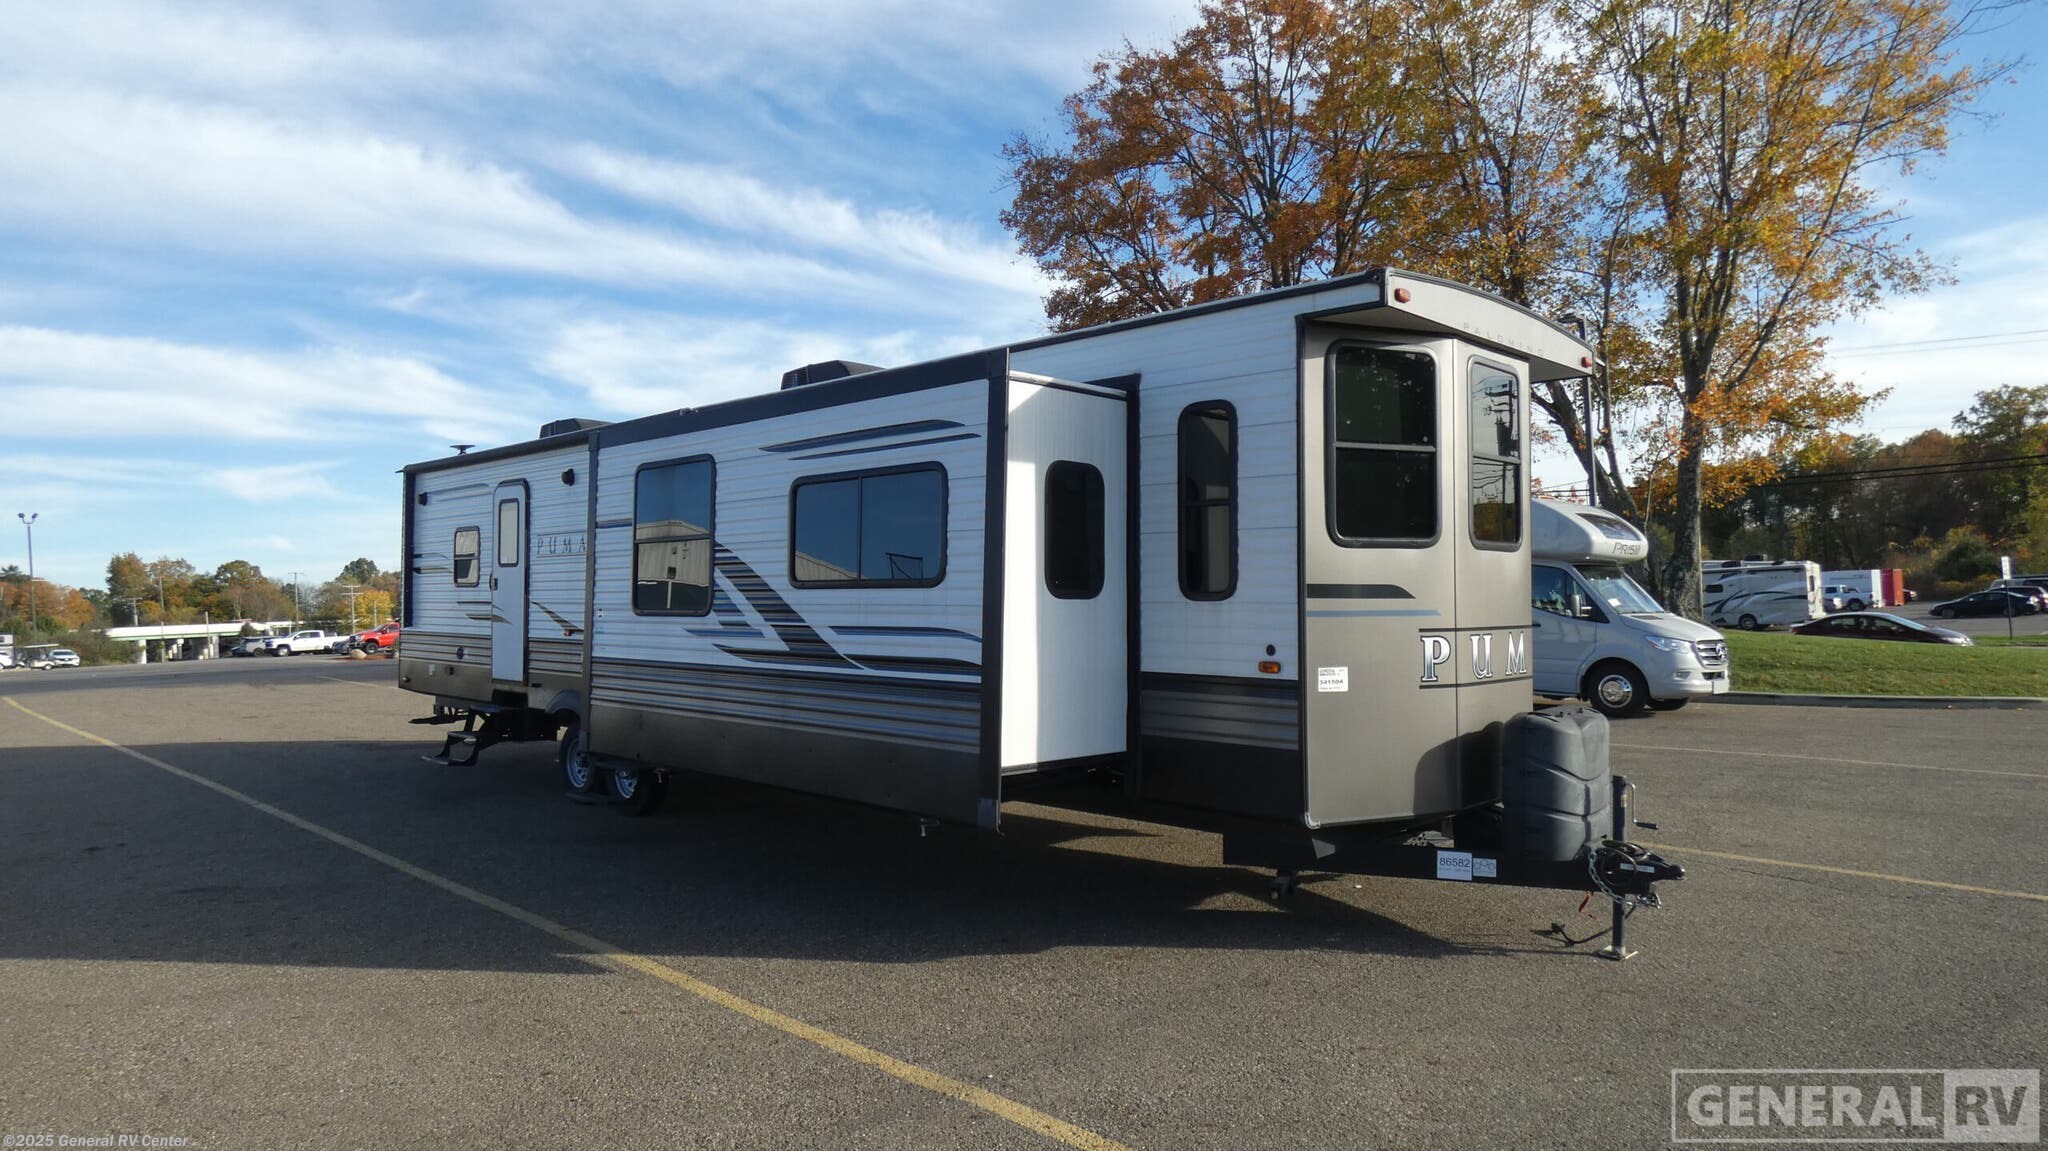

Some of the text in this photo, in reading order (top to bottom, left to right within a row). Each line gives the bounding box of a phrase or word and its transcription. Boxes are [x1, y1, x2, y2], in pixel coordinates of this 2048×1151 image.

[537, 535, 586, 554] PUMA
[1420, 632, 1527, 682] PUM
[1440, 857, 1470, 868] 86582
